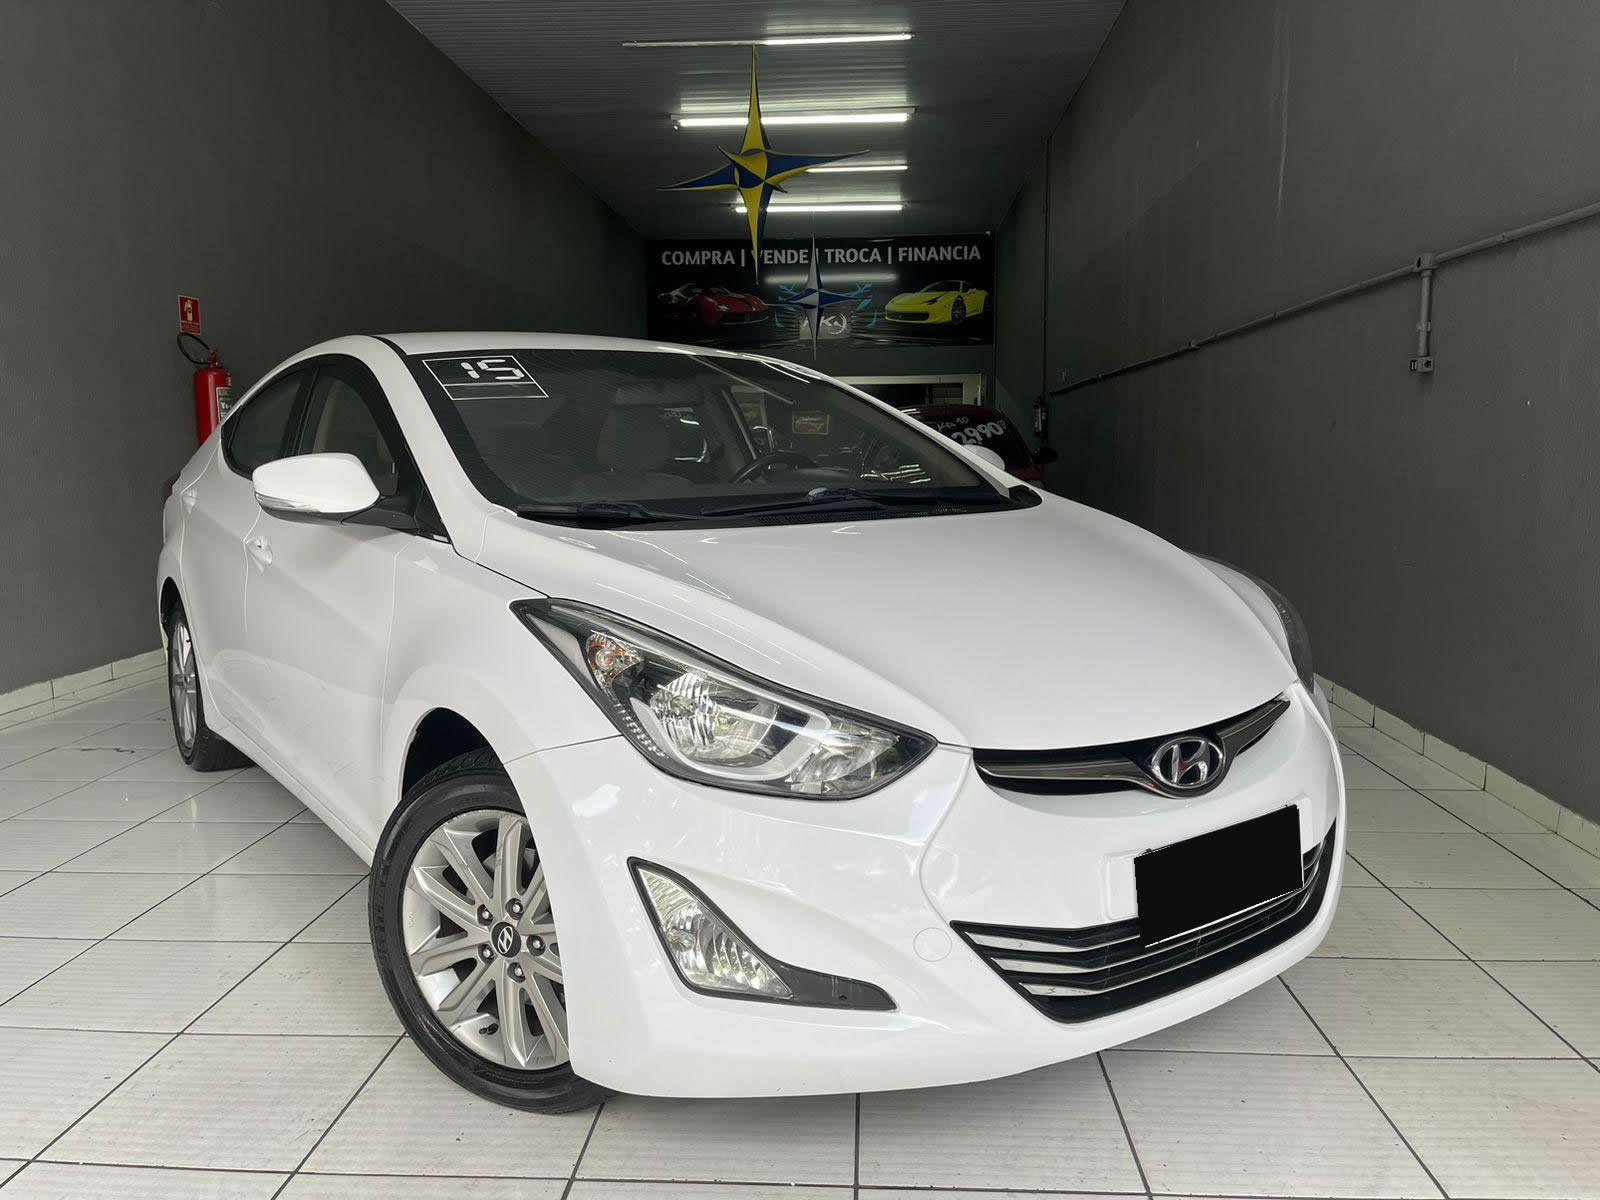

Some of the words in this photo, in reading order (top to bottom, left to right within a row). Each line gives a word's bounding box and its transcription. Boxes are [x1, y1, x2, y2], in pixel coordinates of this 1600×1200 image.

[661, 249, 736, 265] COMPRA
[824, 247, 882, 263] TROCA
[898, 244, 982, 263] FINANCIA
[460, 359, 525, 381] 15
